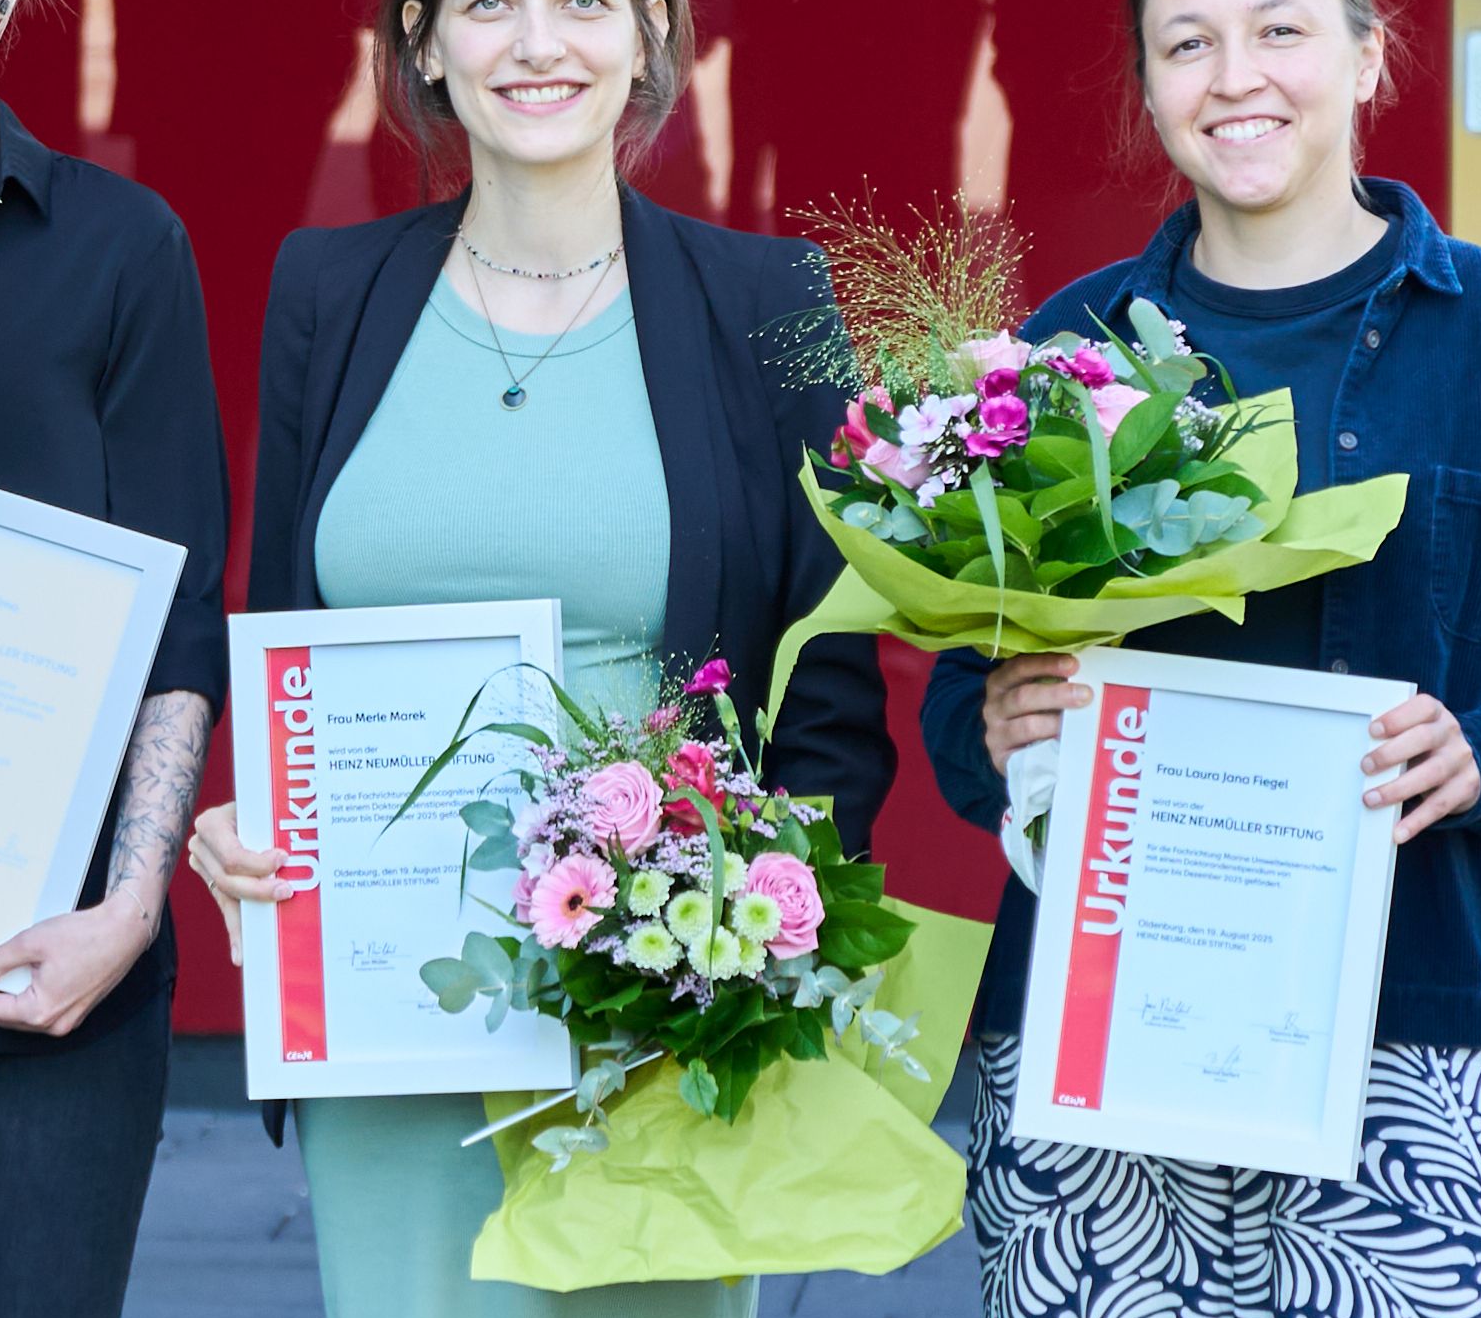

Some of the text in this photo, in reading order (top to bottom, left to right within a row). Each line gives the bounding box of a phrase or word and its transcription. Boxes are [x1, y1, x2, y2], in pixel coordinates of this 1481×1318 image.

[327, 711, 426, 724] Frau Merle Marek
[274, 666, 320, 891] Urkunde
[329, 759, 362, 770] HEINZ
[1157, 763, 1289, 790] Frau Laura Jana Fiegel
[1082, 706, 1147, 936] Urkunde
[1151, 810, 1324, 841] HEINZ NEUMÜLLER STIFTUNG
